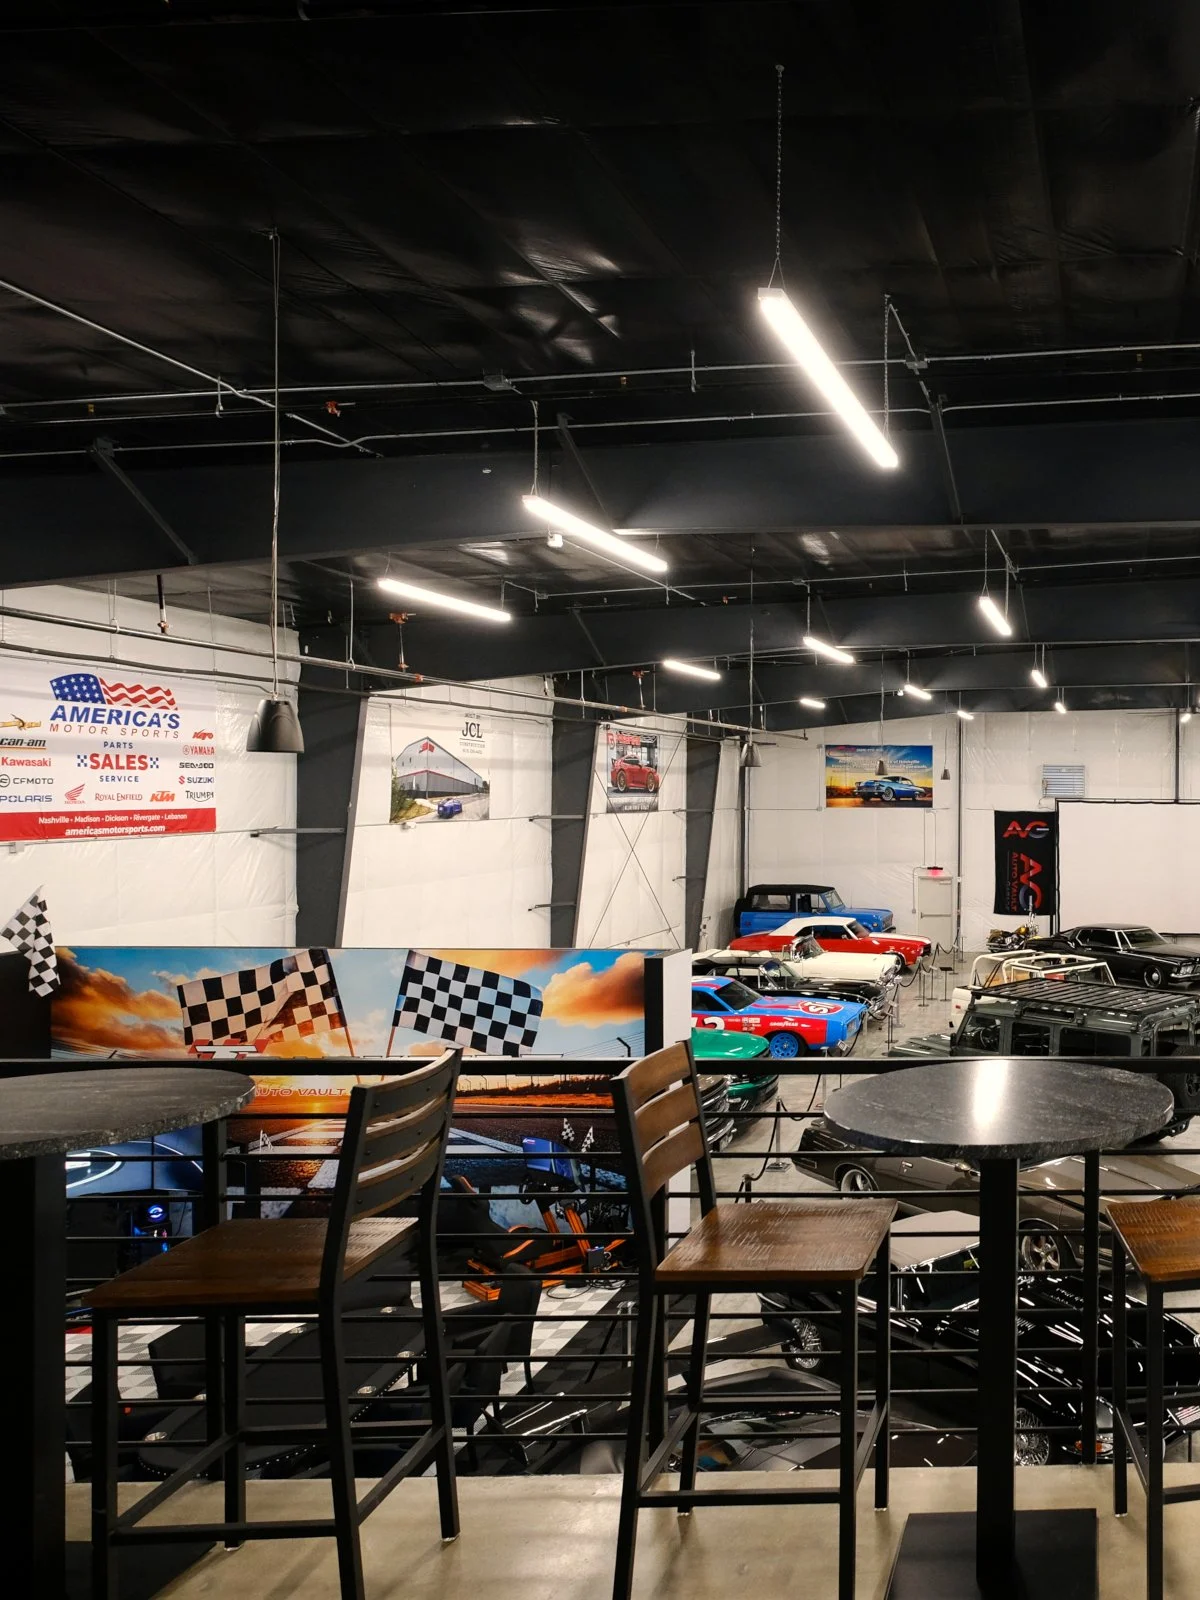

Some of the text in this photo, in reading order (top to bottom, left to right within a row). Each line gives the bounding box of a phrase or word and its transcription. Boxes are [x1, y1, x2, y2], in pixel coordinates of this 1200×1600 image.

[50, 704, 180, 729] AMERICA'S
[49, 723, 179, 739] MOTOR SPORTS
[461, 721, 483, 738] JCL
[0, 737, 46, 747] can-am
[103, 741, 134, 750] PARTS
[1, 757, 52, 767] Kawasaki
[89, 753, 148, 771] SALES
[13, 777, 54, 785] CFMOTO
[99, 775, 140, 783] SERVICE
[187, 776, 215, 784] SUZUKI
[0, 795, 52, 803] POLARIS
[95, 792, 143, 802] ROYAL ENFIELD
[150, 791, 175, 802] KTM
[38, 815, 70, 825] Nashville
[74, 815, 100, 823] Madison
[105, 814, 129, 823] Dickson
[65, 824, 165, 837] americasmotorsports.com
[298, 1088, 346, 1096] VAULT
